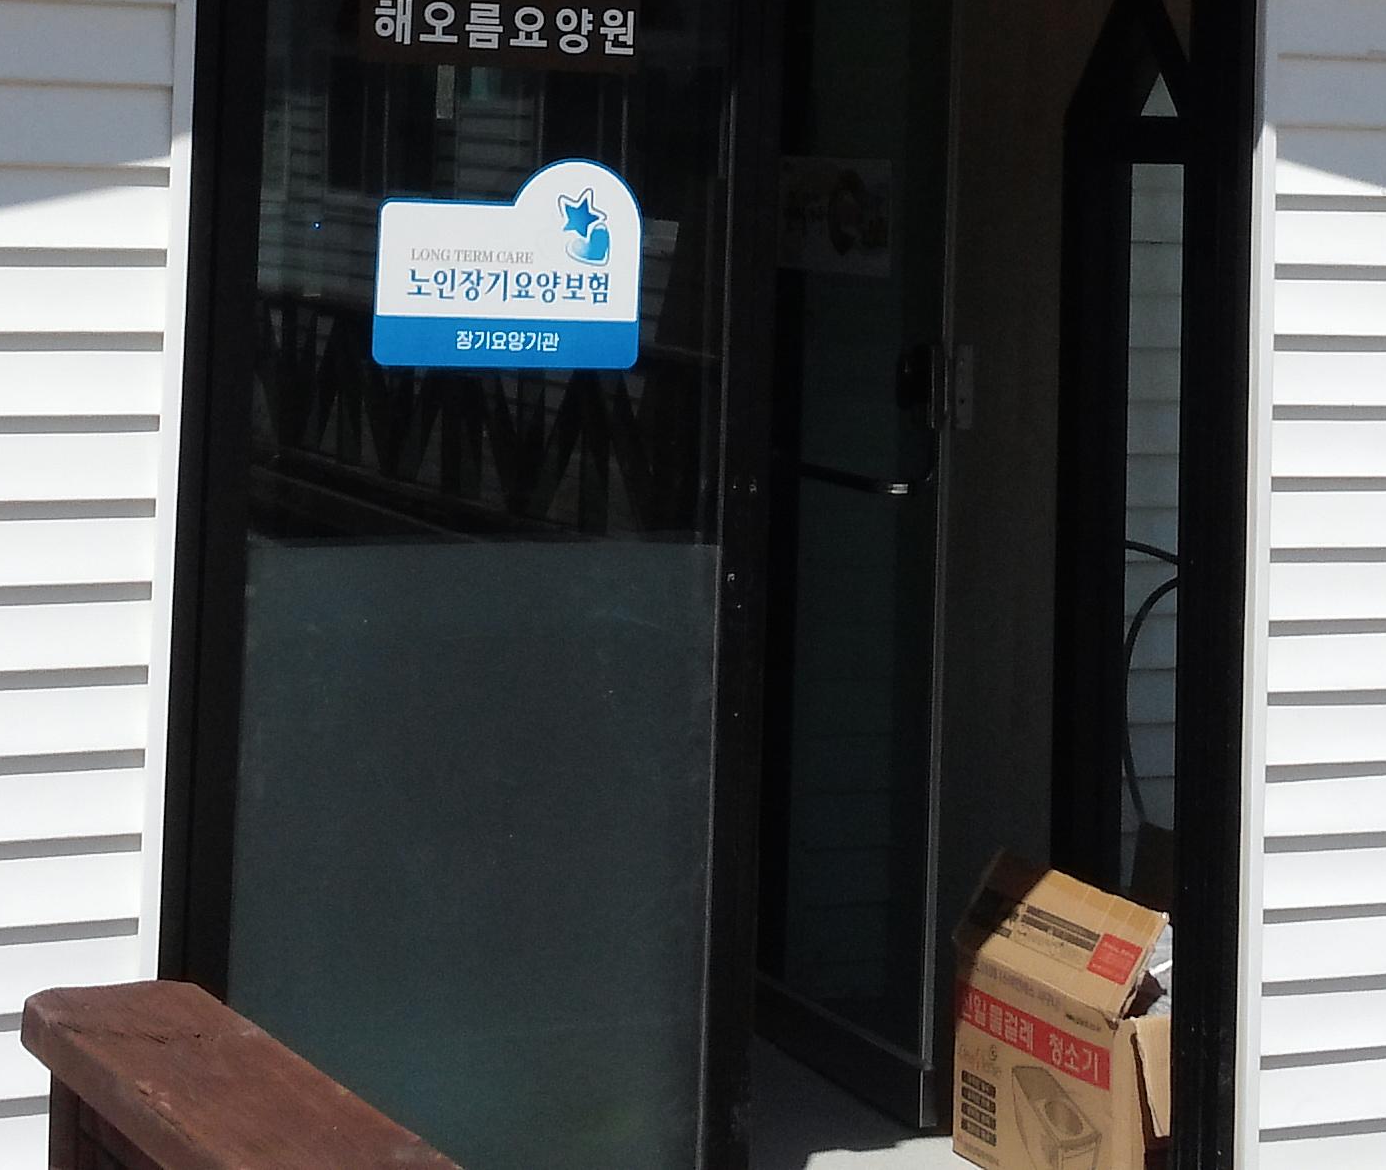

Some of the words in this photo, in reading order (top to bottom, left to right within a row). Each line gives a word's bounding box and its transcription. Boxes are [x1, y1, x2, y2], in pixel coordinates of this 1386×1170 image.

[411, 248, 451, 262] LONG
[454, 249, 494, 263] TERM
[497, 251, 534, 265] CARE
[407, 268, 610, 304] 노인장기요양보험
[456, 330, 560, 352] 장기요양기관
[1048, 1033, 1099, 1083] 청소기
